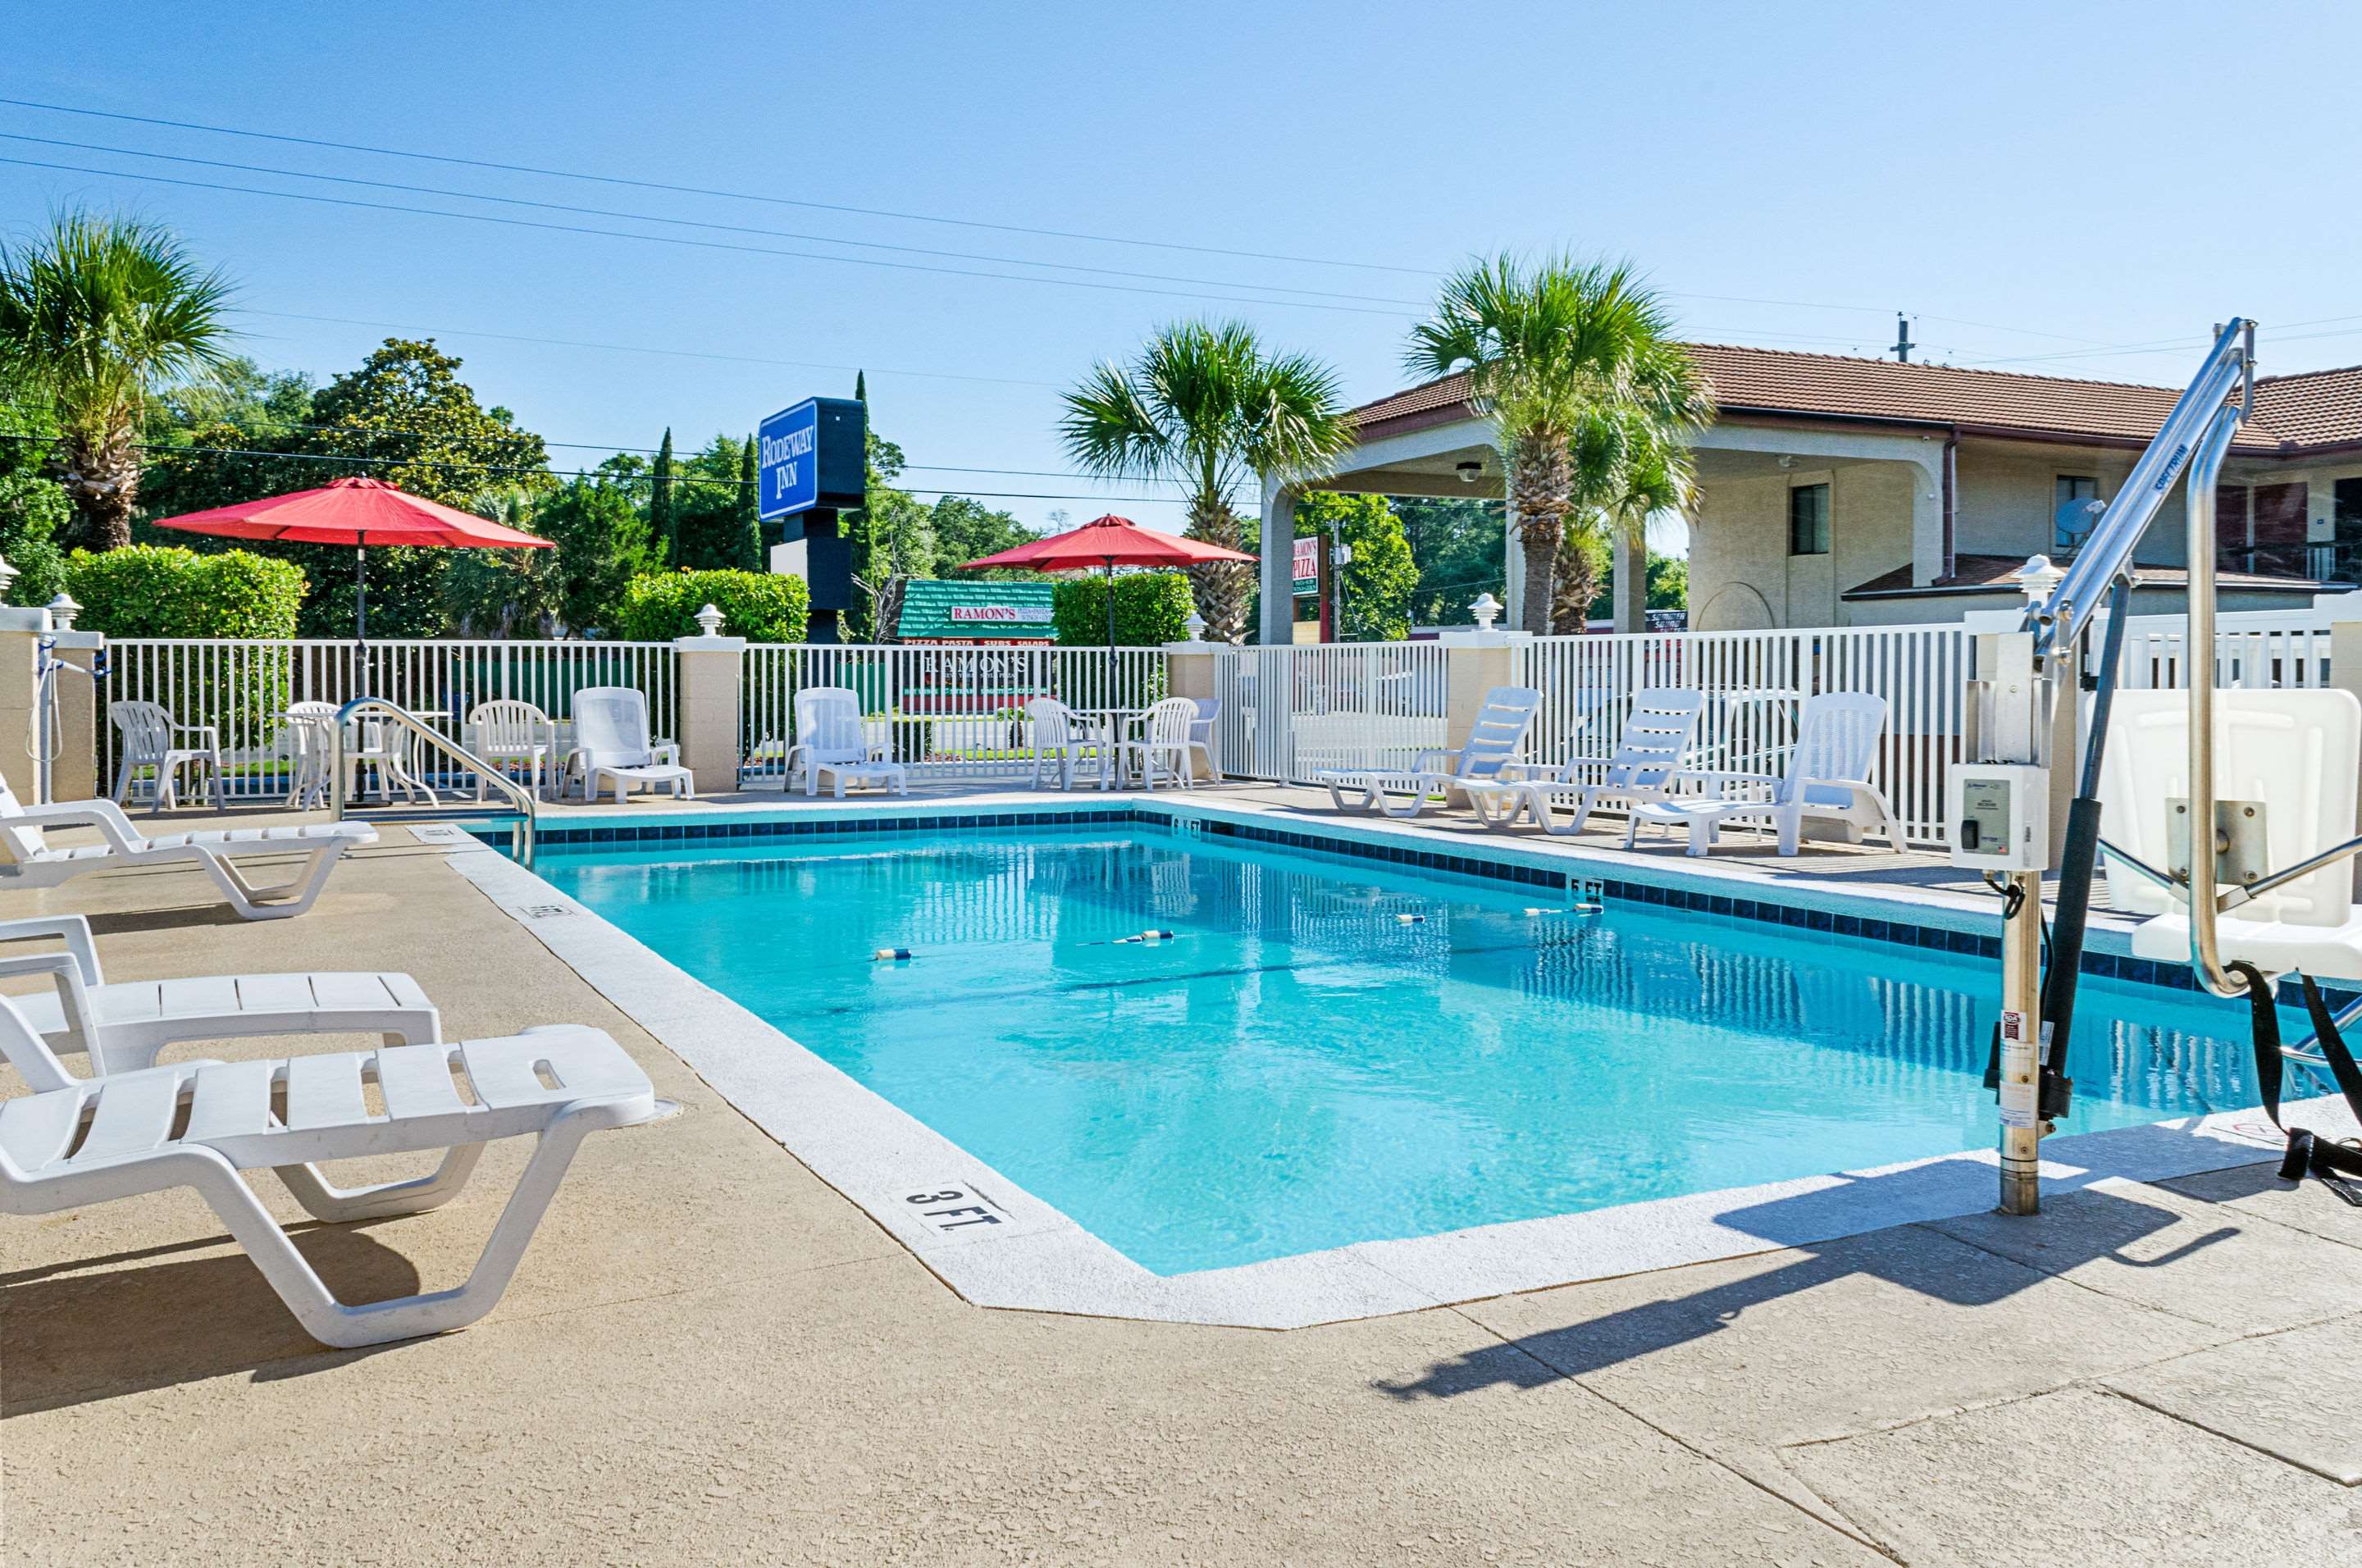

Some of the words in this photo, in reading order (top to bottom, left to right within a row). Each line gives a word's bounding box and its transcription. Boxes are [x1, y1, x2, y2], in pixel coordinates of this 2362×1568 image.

[762, 425, 814, 469] RODEWAY
[776, 461, 798, 499] INN
[1293, 558, 1316, 578] PIZZA
[954, 608, 1015, 620] RAMON'S
[1585, 881, 1602, 895] FT
[906, 1190, 964, 1204] 3
